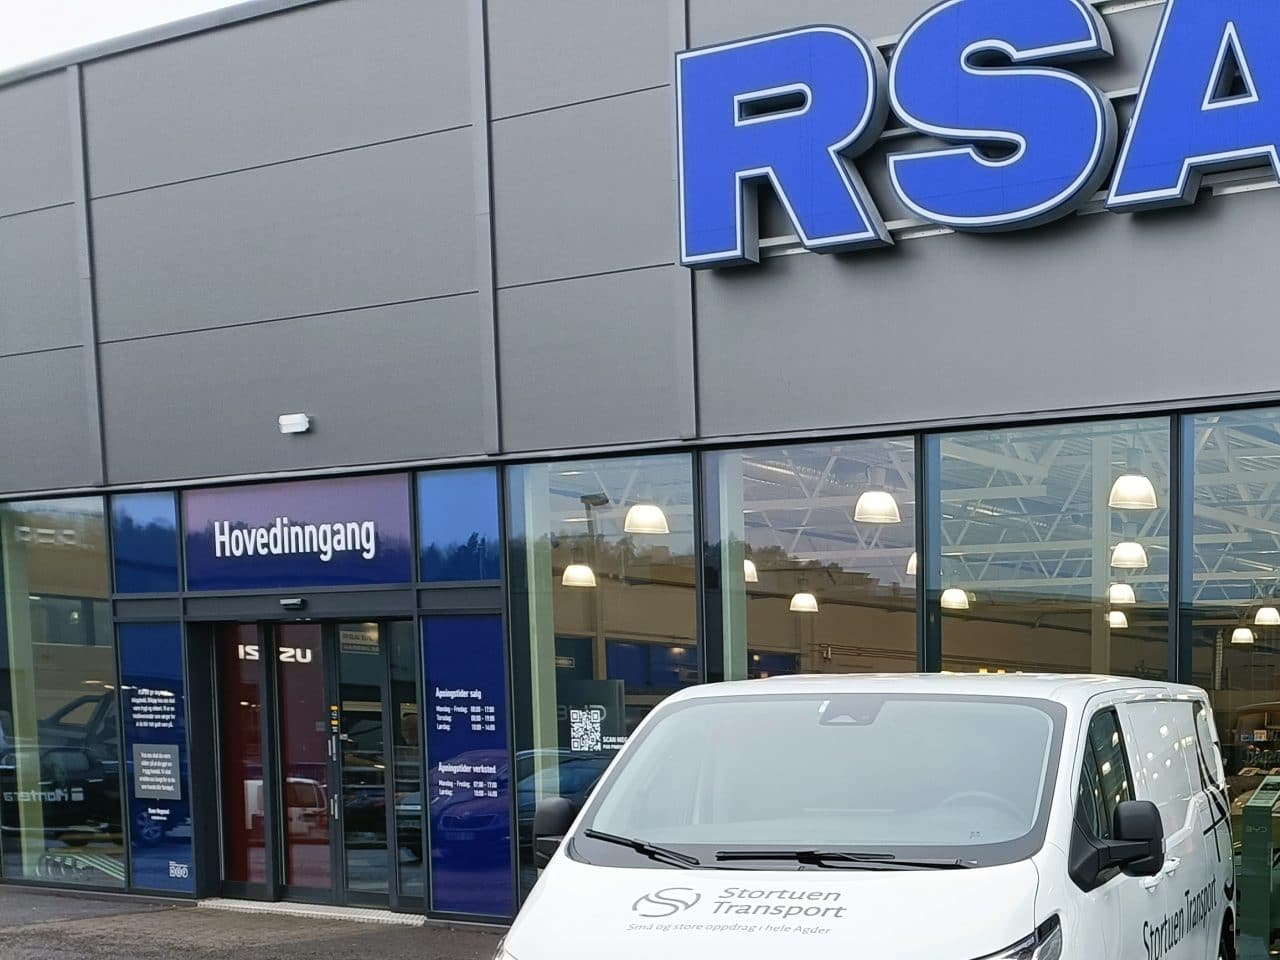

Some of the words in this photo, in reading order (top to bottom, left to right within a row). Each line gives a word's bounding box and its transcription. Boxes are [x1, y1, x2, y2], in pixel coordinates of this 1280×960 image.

[214, 517, 375, 561] Hovedinngang
[238, 645, 312, 663] ISZU
[718, 886, 842, 902] Stortuen
[712, 901, 847, 919] Transport
[1184, 874, 1217, 934] Transport
[655, 922, 672, 932] og
[673, 923, 703, 931] store
[705, 923, 757, 933] oppdrag
[764, 924, 792, 933] hele
[793, 925, 831, 935] Agder
